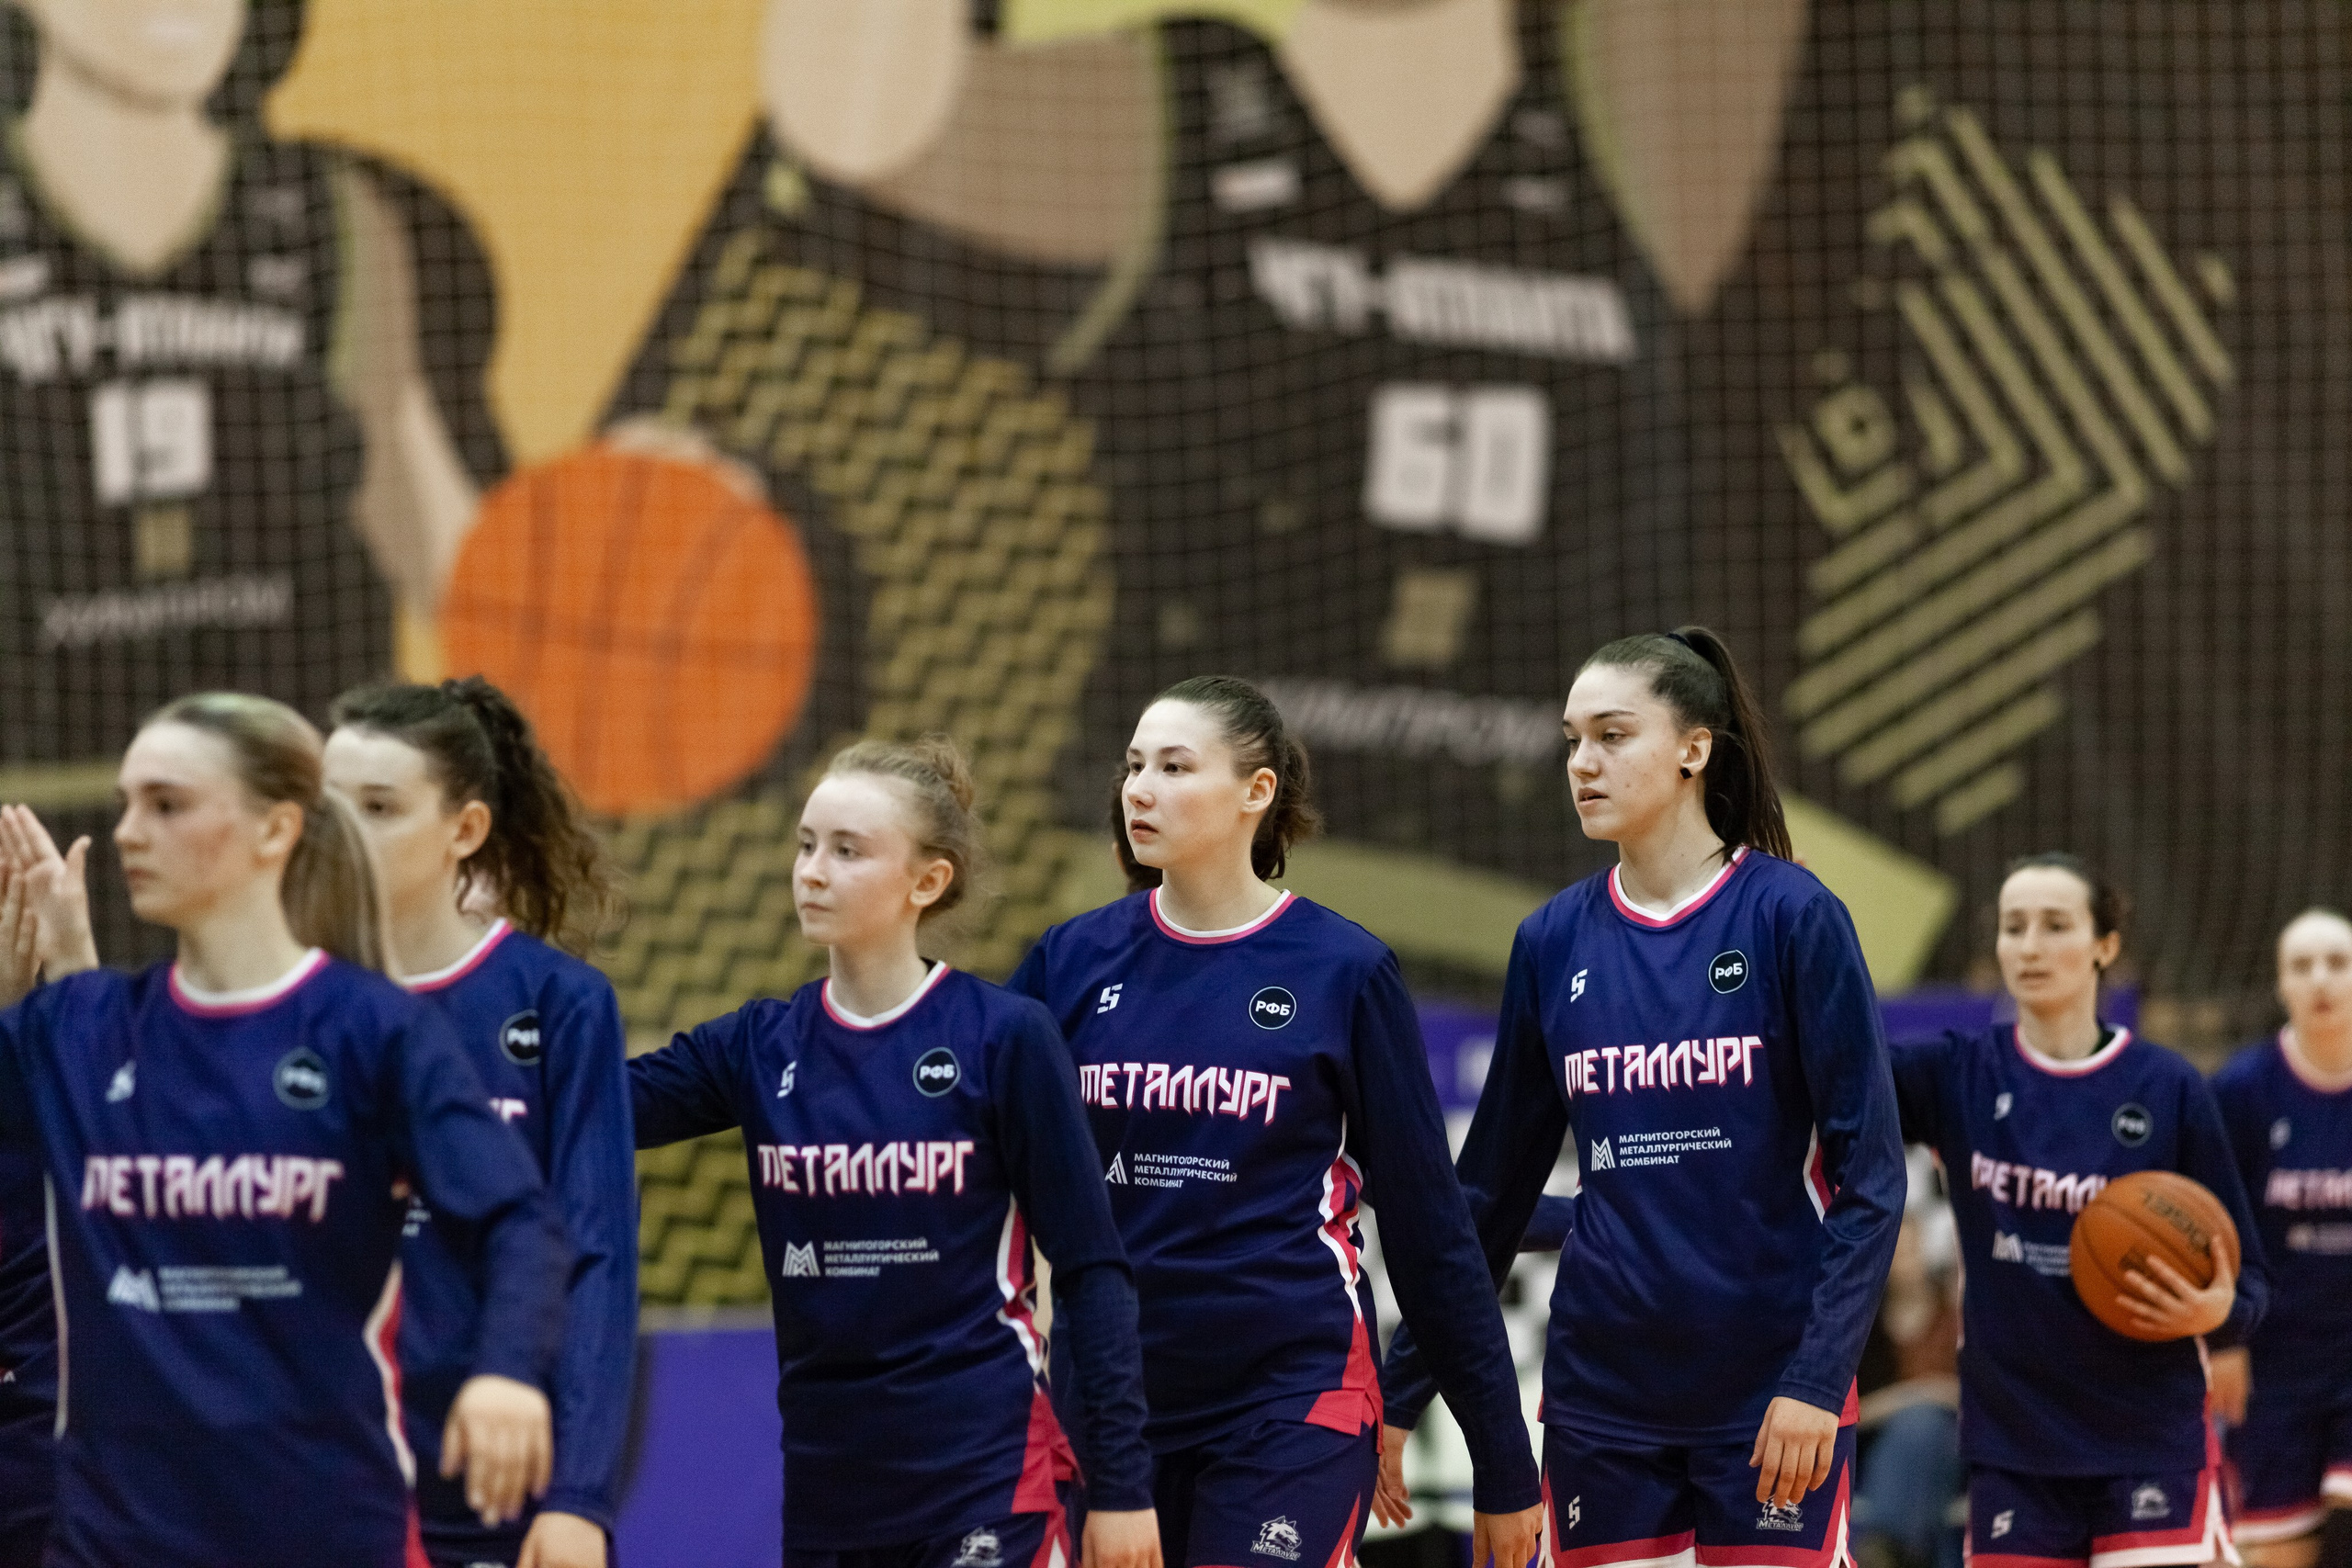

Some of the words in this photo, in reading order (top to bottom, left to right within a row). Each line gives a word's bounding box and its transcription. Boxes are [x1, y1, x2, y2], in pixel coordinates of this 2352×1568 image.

[94, 375, 211, 507] 19
[1363, 378, 1552, 547] 60
[1715, 962, 1744, 980] РФБ
[1255, 999, 1292, 1017] РФБ
[920, 1064, 956, 1080] РФБ
[1564, 1034, 1765, 1101] МЕТАЛЛУРГ
[1079, 1061, 1293, 1126] МЕТАЛЛУРГ
[1619, 1126, 1722, 1145] МАГНИТОГОРСКИЙ
[1619, 1137, 1733, 1156] МЕТАЛЛУРГИЧЕСКИЙ
[757, 1140, 976, 1198] МЕТАЛЛУРГ
[1134, 1153, 1230, 1170] МАГНИТОГОРСКИЙ
[1620, 1155, 1680, 1168] КОМБИНАТ
[1134, 1165, 1238, 1183] МЕТАЛЛУРГИЧЕСКИЙ
[1134, 1176, 1184, 1189] КОМБИНАТ
[1971, 1149, 2108, 1217] МЕТАЛЛ
[81, 1154, 346, 1224] МЕТАЛЛУРГ
